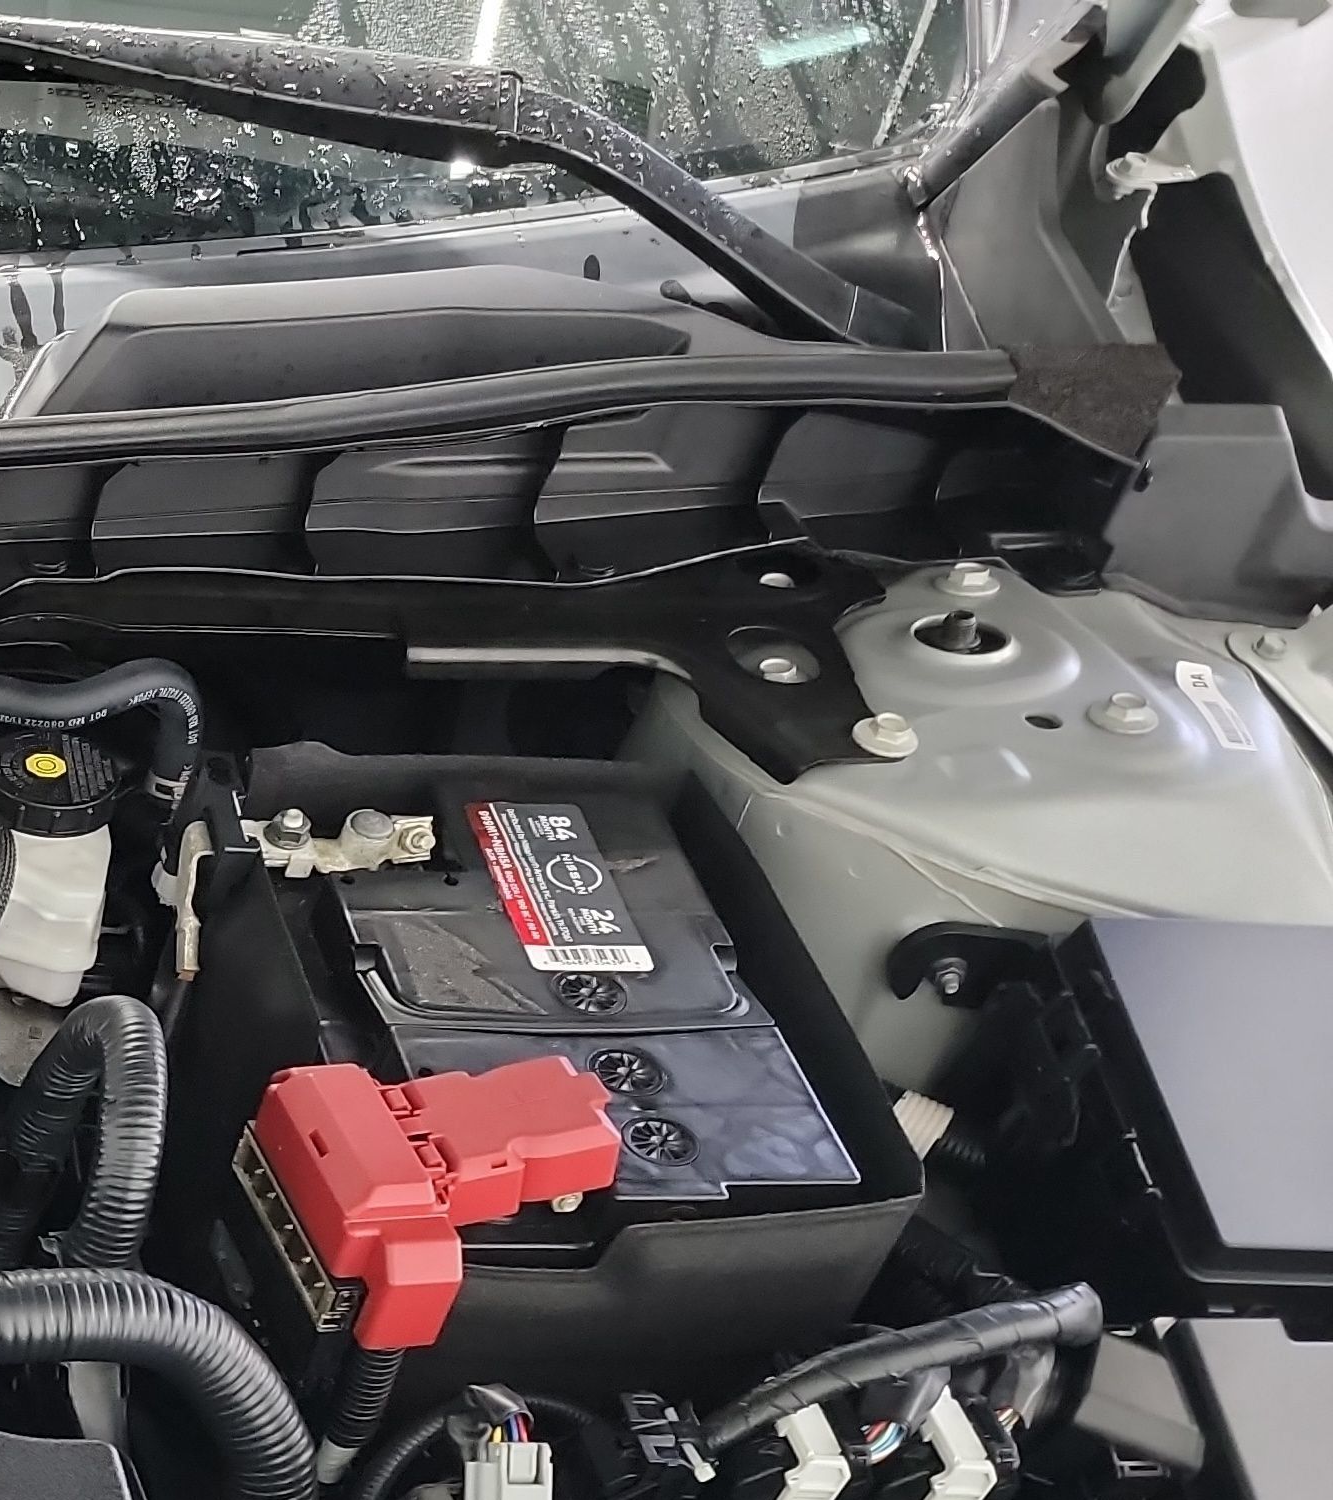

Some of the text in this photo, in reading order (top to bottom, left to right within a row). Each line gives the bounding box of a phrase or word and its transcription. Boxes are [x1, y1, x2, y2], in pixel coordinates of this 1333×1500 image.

[538, 815, 557, 841] MONTH
[549, 816, 579, 841] 84
[560, 853, 590, 895] NISSAN
[580, 908, 600, 935] MONTH
[590, 909, 622, 935] 24
